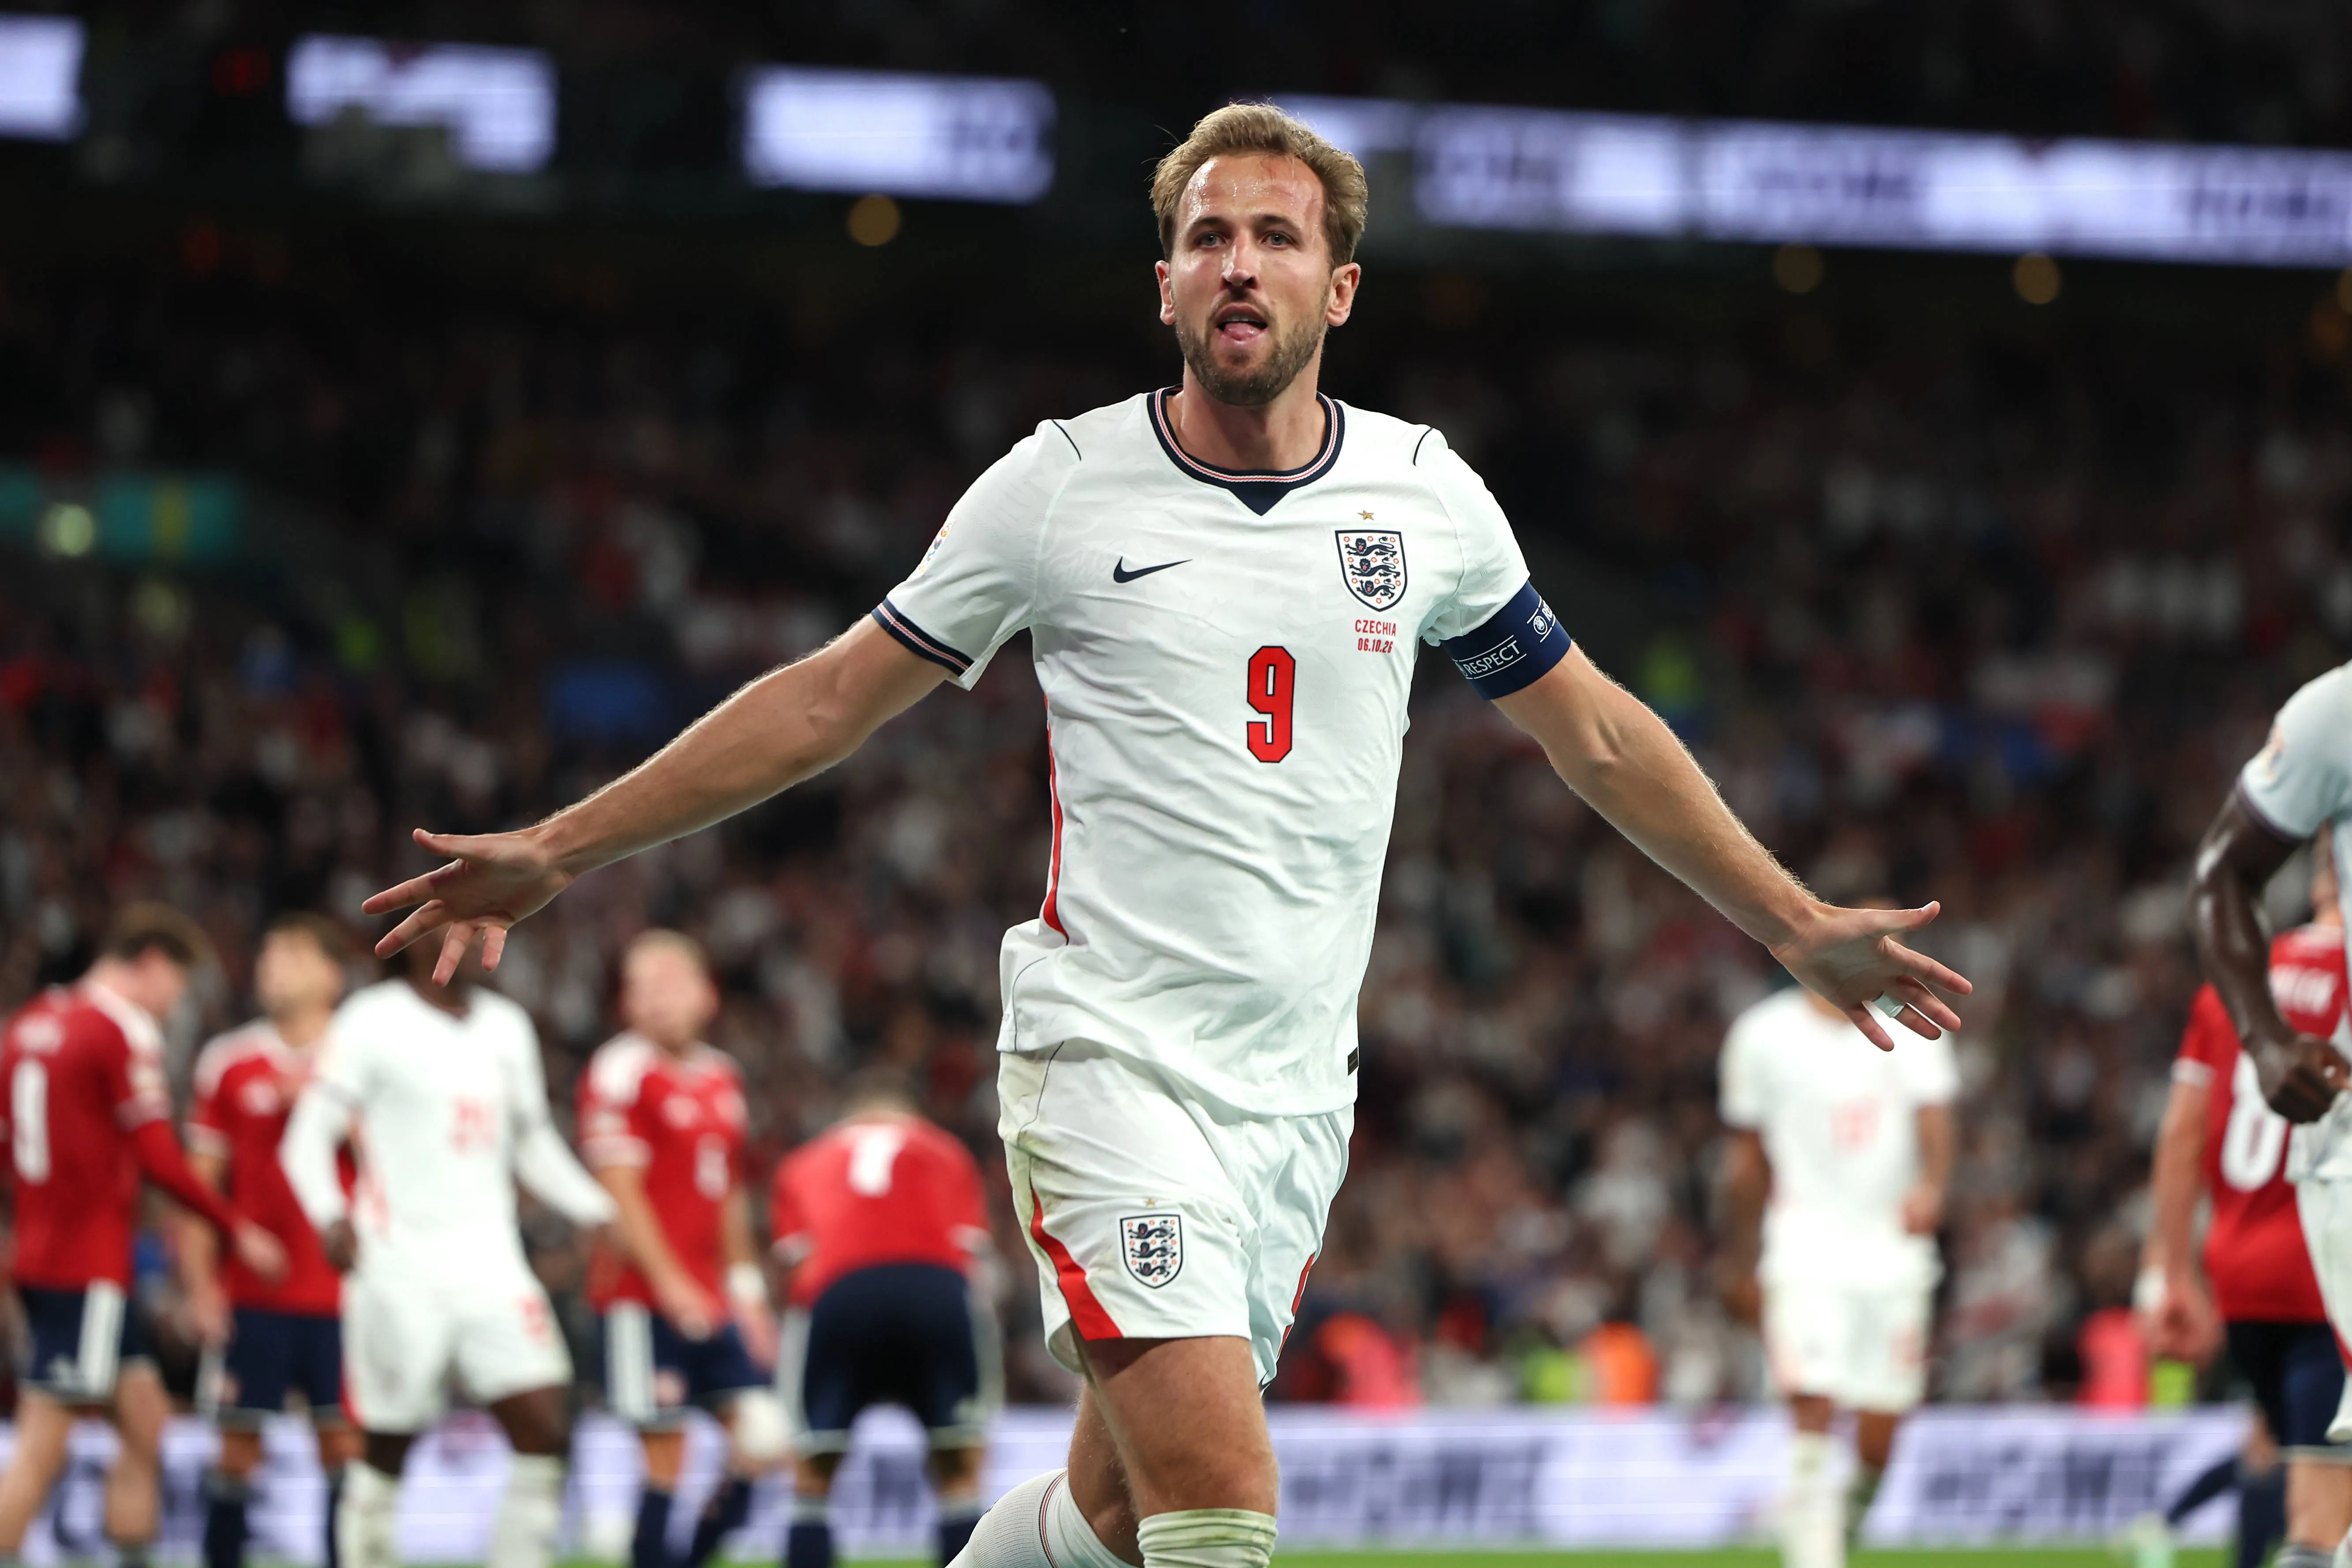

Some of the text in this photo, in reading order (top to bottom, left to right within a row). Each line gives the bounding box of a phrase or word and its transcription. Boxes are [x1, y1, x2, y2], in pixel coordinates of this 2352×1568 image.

[1355, 619, 1396, 636] CZECHIA
[1358, 638, 1393, 654] 06.10.26
[1463, 640, 1520, 675] RESPECT
[1247, 646, 1296, 763] 9
